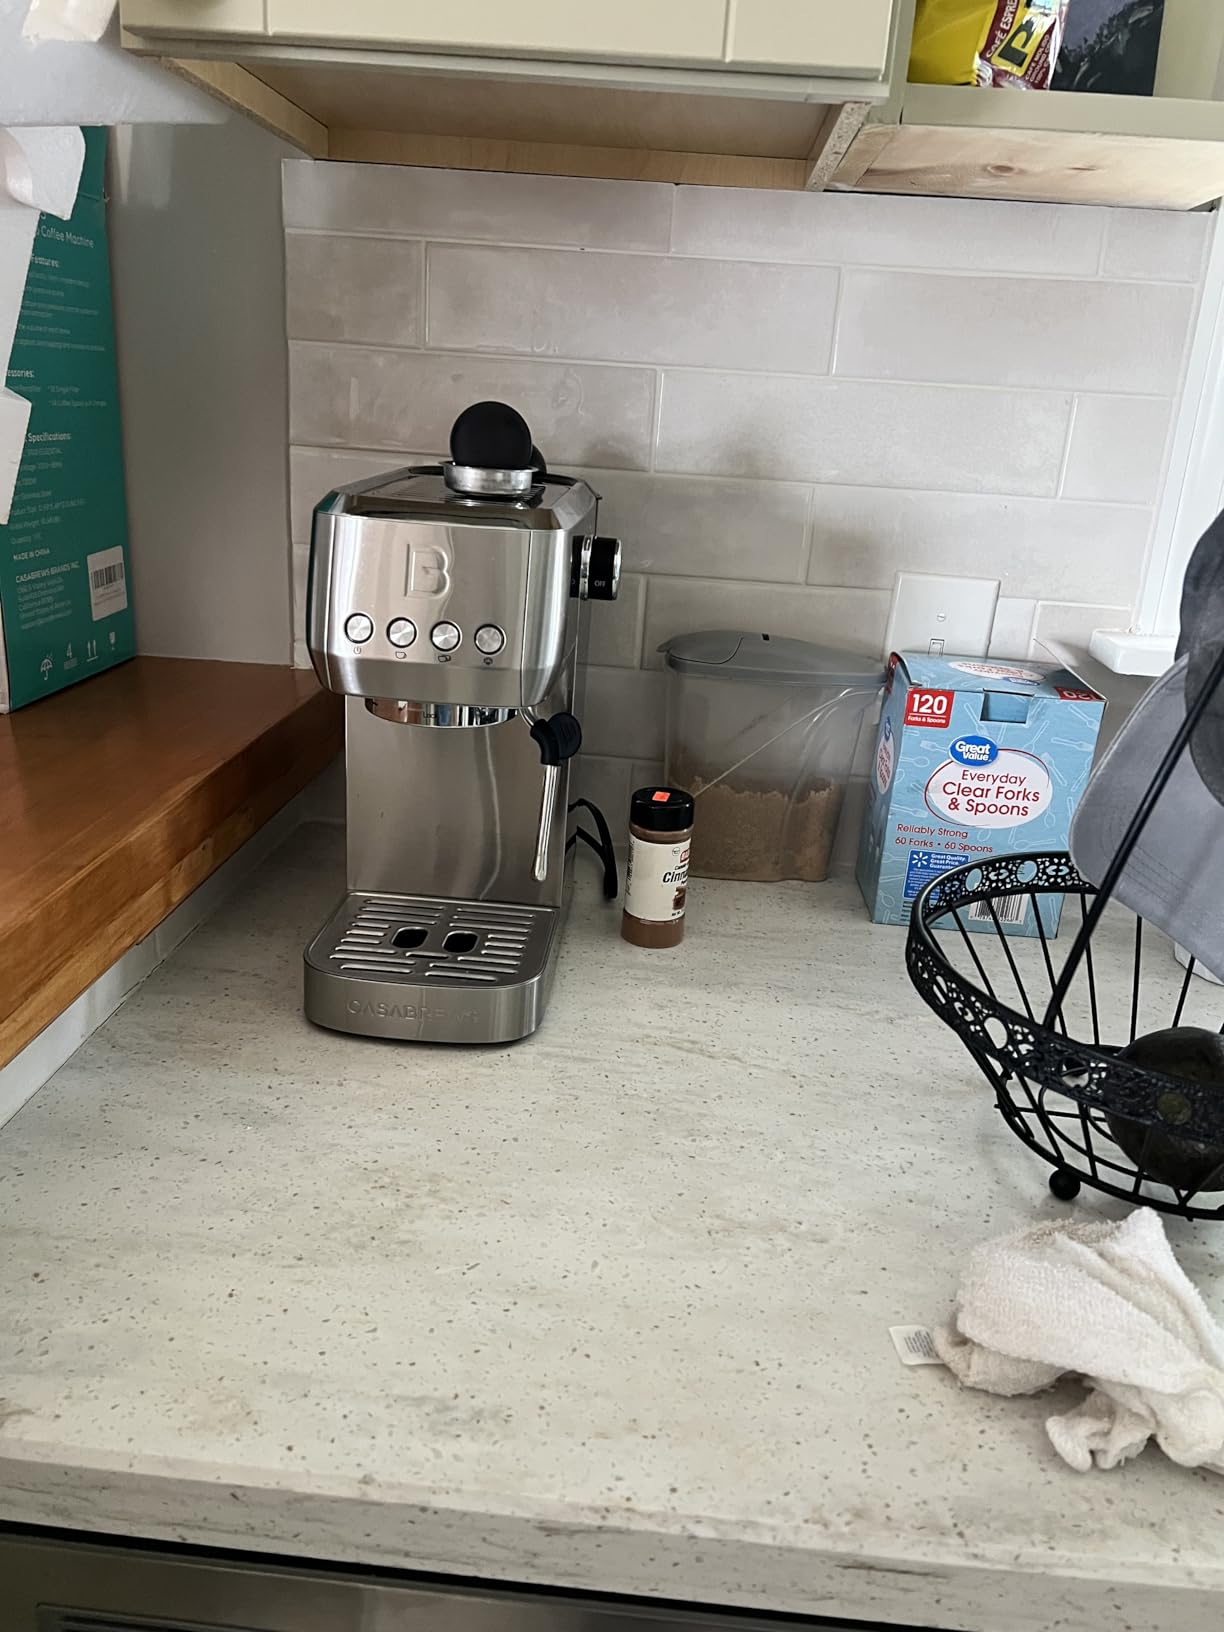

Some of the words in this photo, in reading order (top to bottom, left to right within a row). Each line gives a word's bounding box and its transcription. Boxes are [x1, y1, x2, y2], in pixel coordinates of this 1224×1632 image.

[41, 225, 65, 242] Coffee
[65, 231, 94, 248] Machine
[913, 693, 948, 715] 120
[926, 716, 946, 724] Spoons
[955, 740, 991, 756] Great
[962, 751, 989, 762] Value
[961, 769, 1027, 787] Everyday
[942, 781, 991, 799] Clear
[995, 786, 1040, 802] Forks
[947, 797, 960, 811] &
[965, 798, 1029, 817] Spoons
[896, 823, 935, 836] Reliably
[938, 827, 968, 840] Strong
[895, 836, 907, 845] 60
[908, 837, 934, 848] Forks
[944, 841, 956, 850] 60
[958, 842, 993, 853] Spoons
